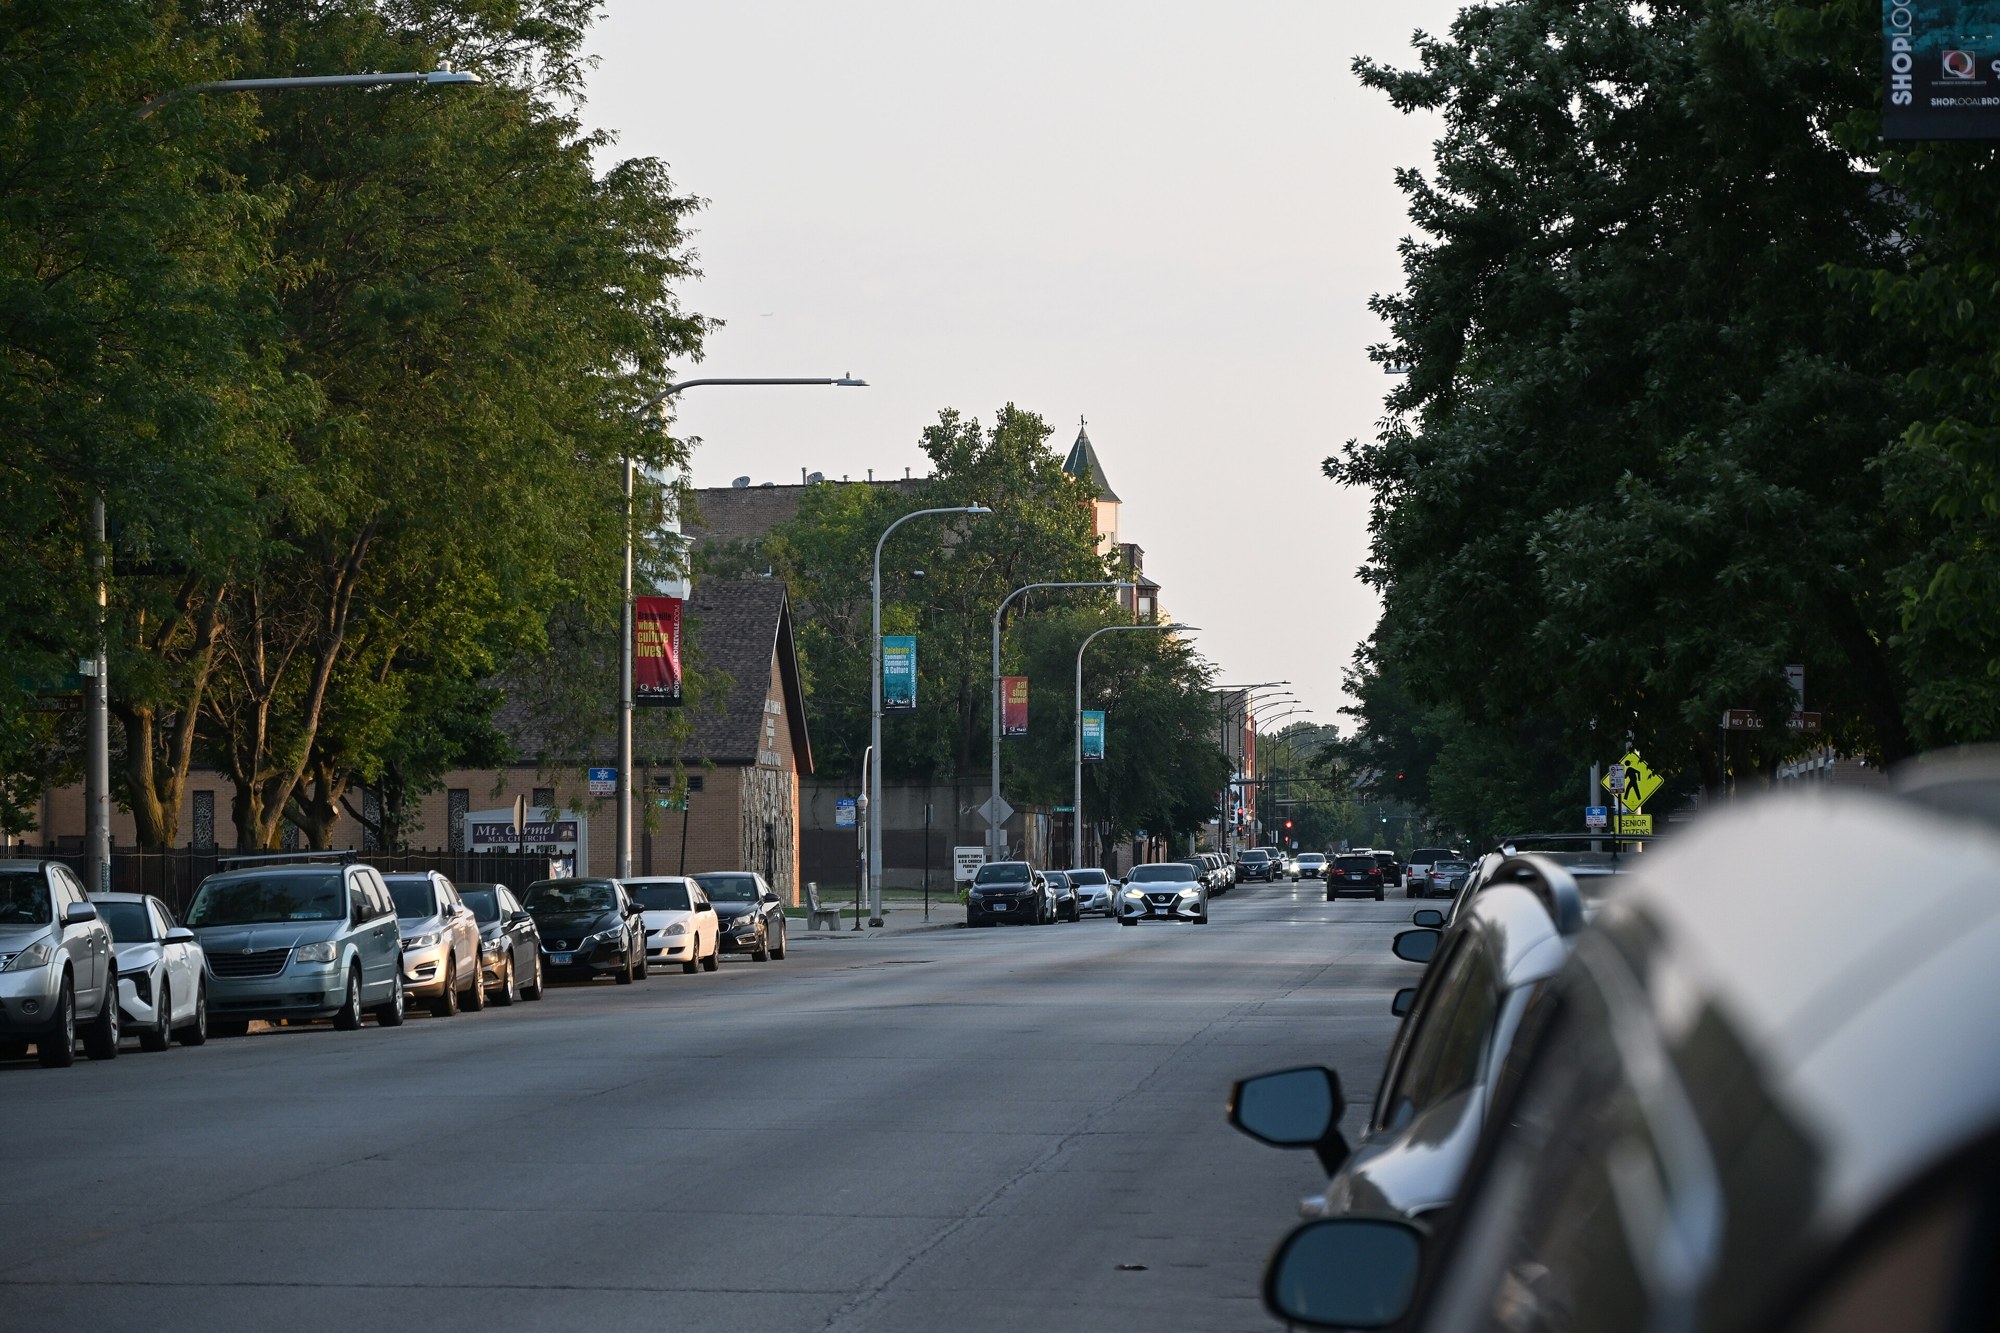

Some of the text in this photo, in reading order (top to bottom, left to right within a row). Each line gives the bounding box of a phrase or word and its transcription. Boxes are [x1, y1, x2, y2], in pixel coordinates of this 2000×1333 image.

[637, 631, 669, 643] culture
[637, 643, 665, 657] lives!
[1621, 819, 1646, 827] SENIOR
[475, 825, 499, 836] Mt.
[505, 823, 555, 835] Crmel
